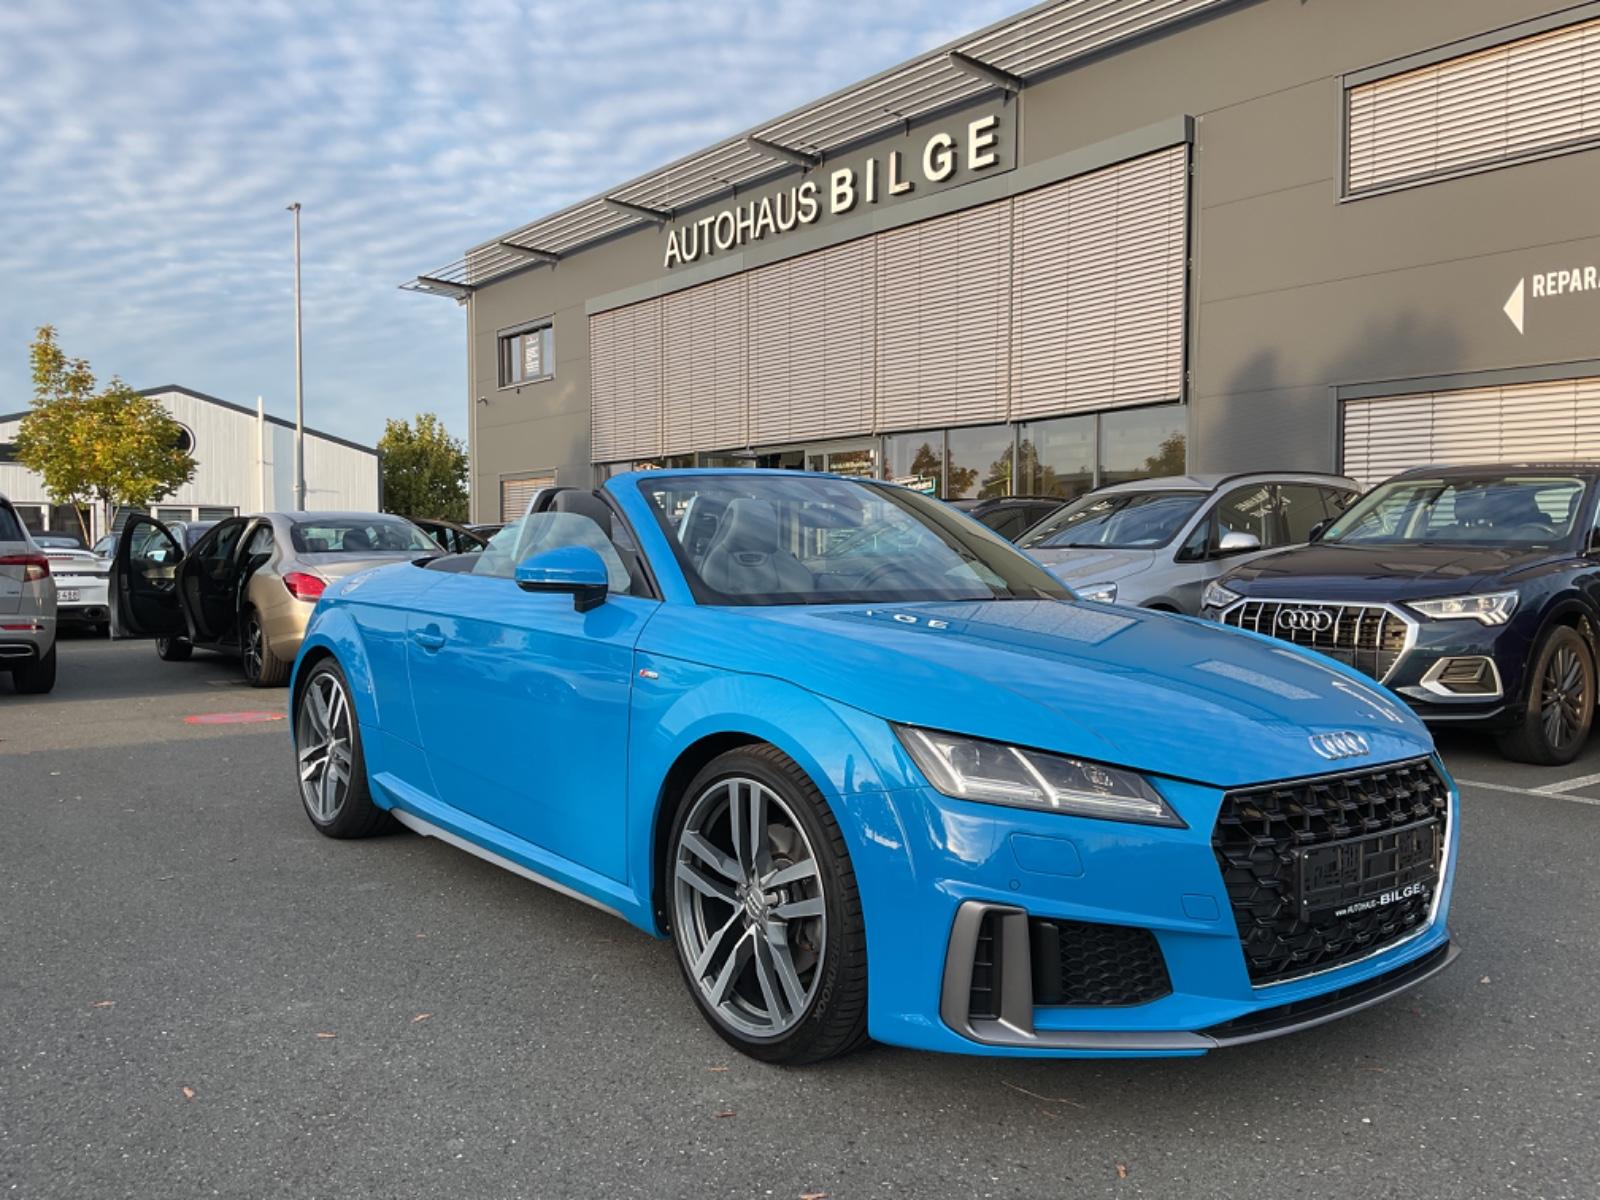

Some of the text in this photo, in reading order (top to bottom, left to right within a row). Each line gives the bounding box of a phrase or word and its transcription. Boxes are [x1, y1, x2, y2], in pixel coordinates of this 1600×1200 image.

[664, 115, 999, 268] AUTOHAUS BILGE
[1532, 265, 1600, 298] REPAR
